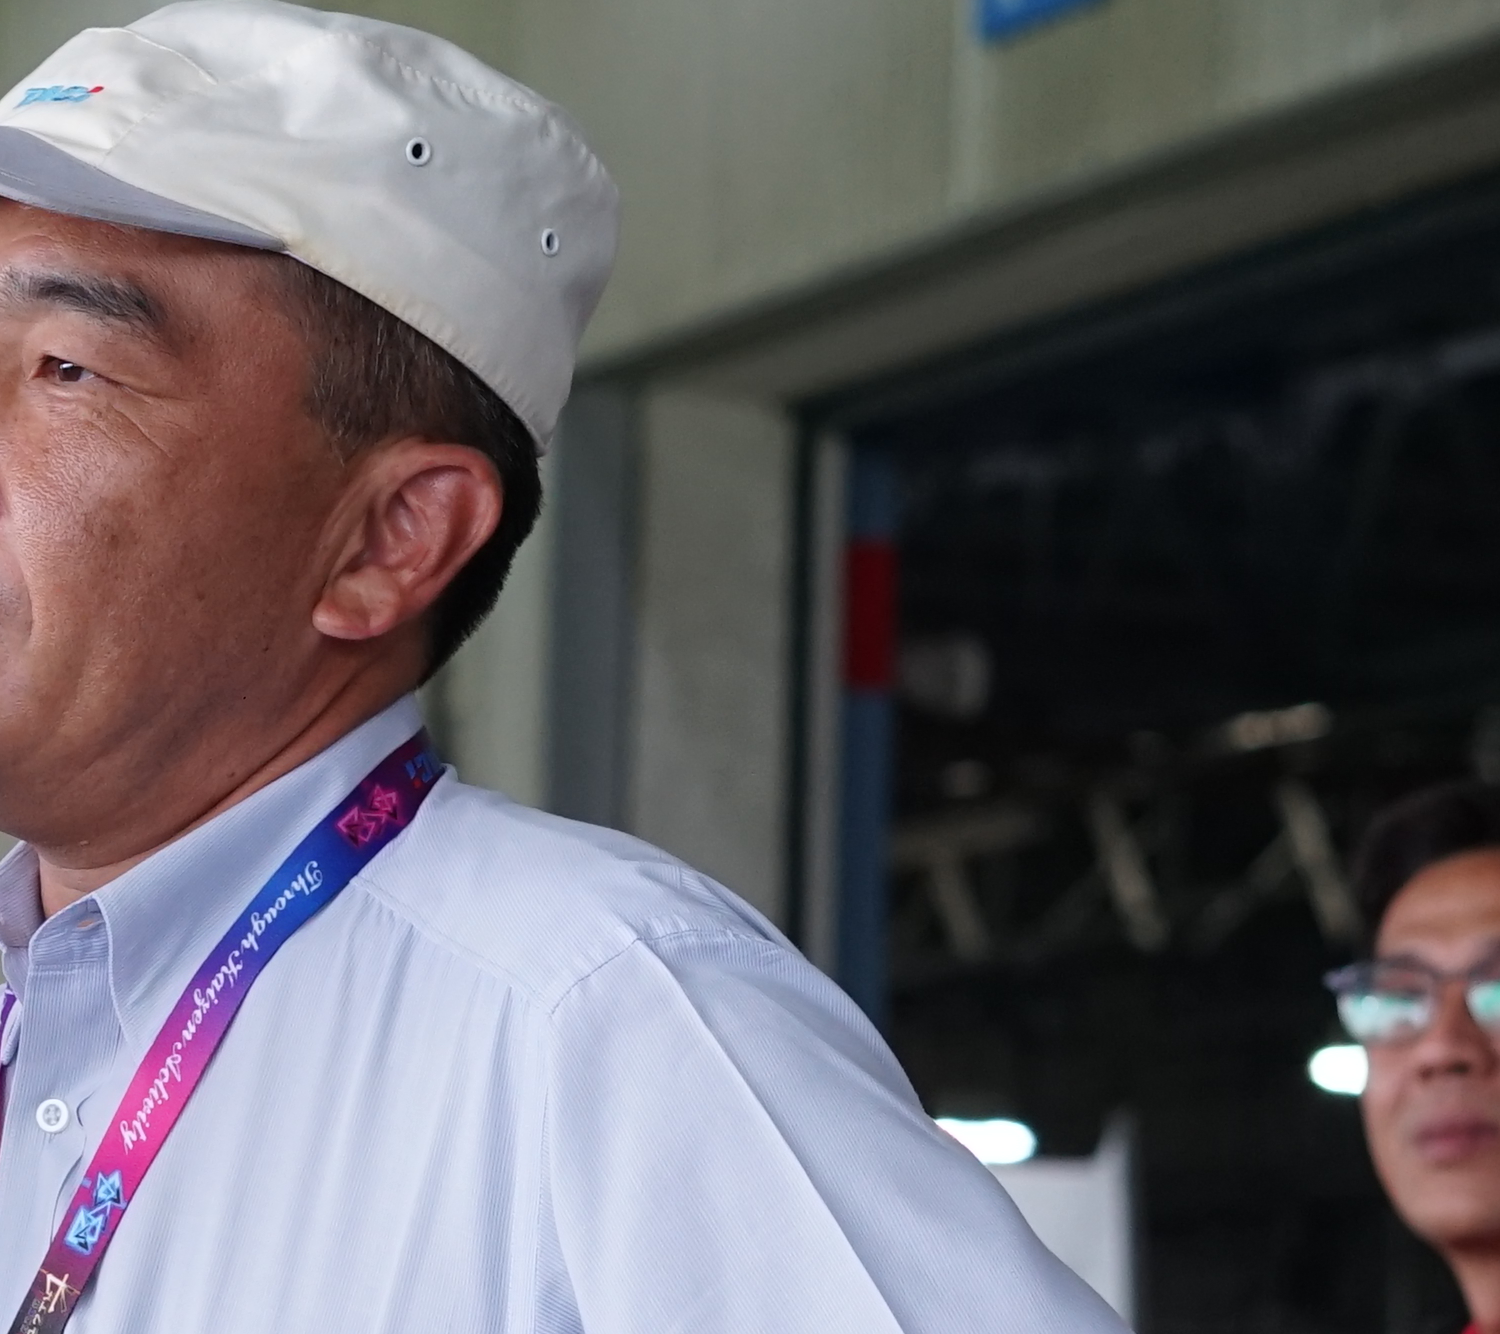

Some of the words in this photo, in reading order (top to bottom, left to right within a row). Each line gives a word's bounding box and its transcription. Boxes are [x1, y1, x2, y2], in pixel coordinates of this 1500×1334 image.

[241, 860, 323, 952] Through
[181, 950, 244, 1048] Kaizen
[119, 1041, 183, 1155] Activity
